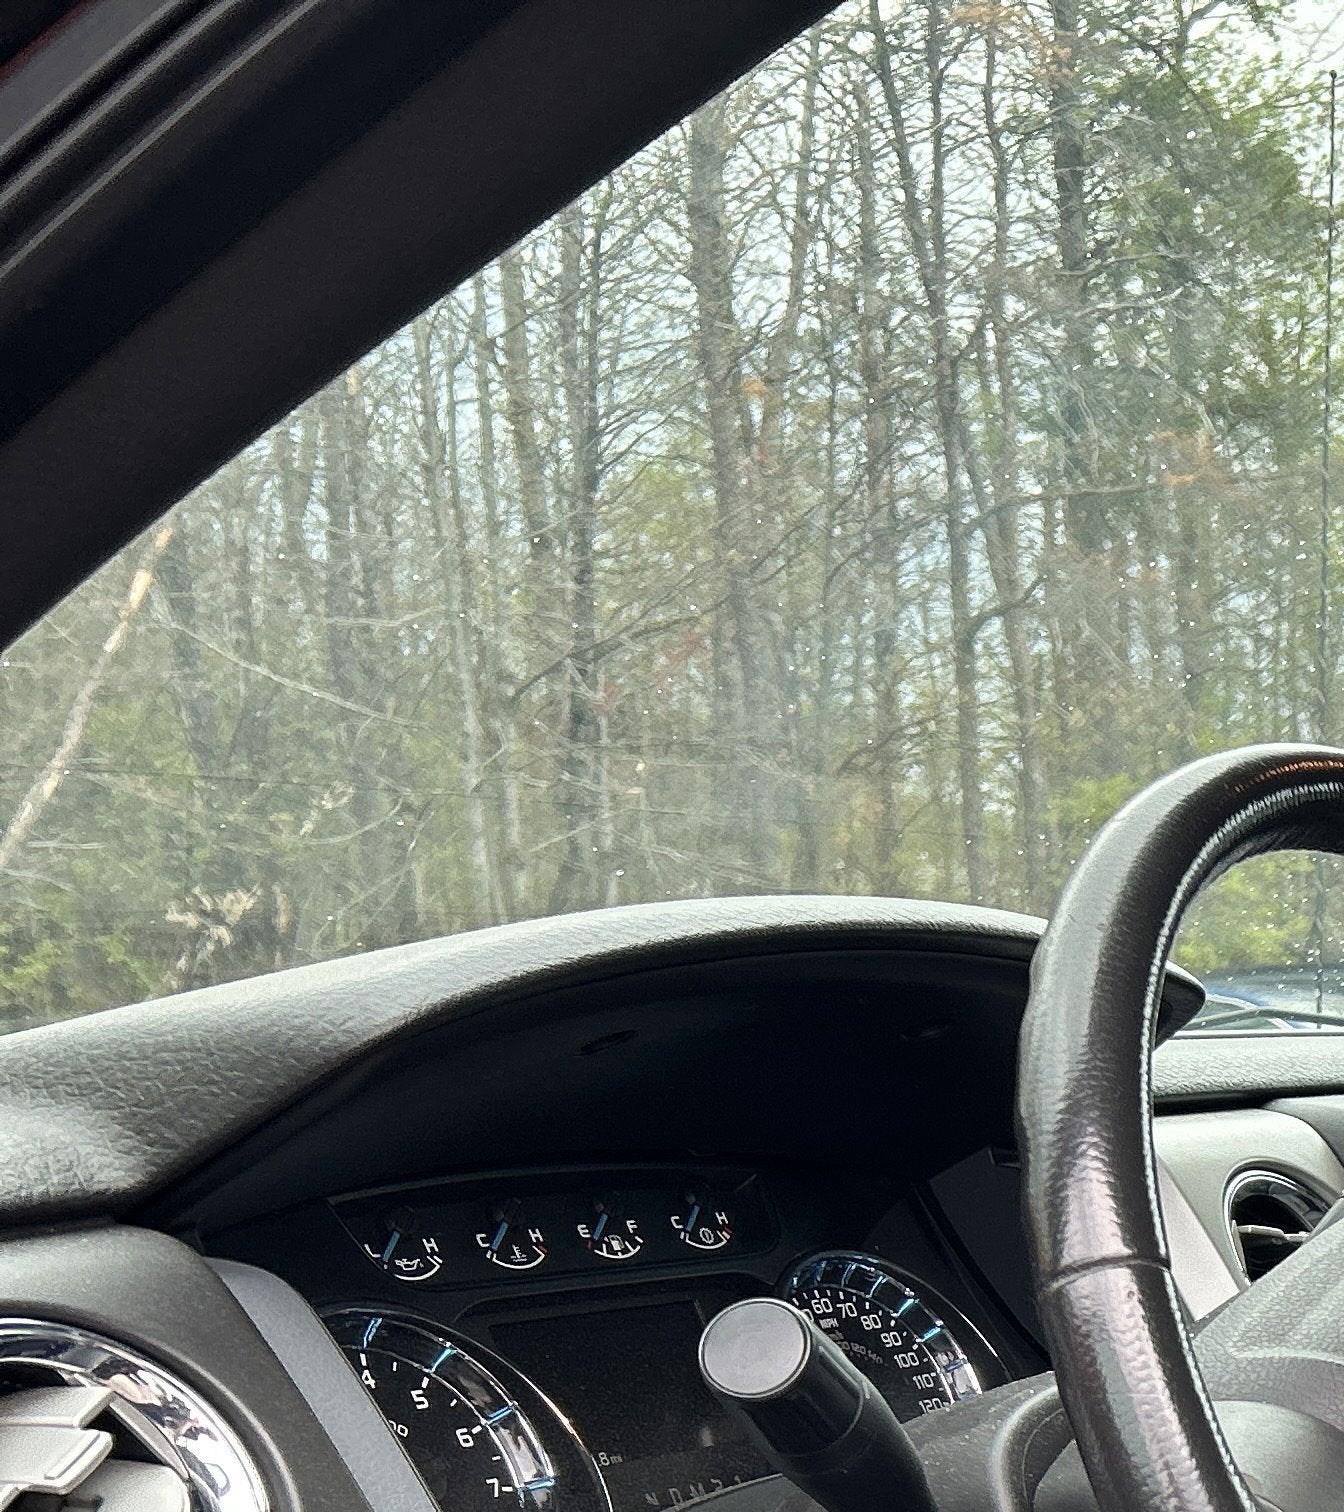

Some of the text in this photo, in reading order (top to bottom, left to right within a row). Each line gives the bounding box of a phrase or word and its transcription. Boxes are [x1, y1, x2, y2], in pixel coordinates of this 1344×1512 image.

[626, 1220, 638, 1233] F
[670, 1216, 684, 1229] C
[715, 1212, 729, 1225] H
[528, 1228, 544, 1242] H
[577, 1224, 591, 1238] E
[422, 1238, 439, 1253] H
[476, 1233, 490, 1248] C
[811, 1298, 833, 1314] 60
[836, 1302, 857, 1318] 70
[860, 1314, 882, 1331] 80
[880, 1331, 902, 1348] 90
[893, 1352, 920, 1369] 100
[362, 1370, 375, 1389] 4
[912, 1373, 934, 1390] 110
[410, 1389, 429, 1410] 5
[455, 1428, 474, 1448] 6
[485, 1478, 499, 1498] 7
